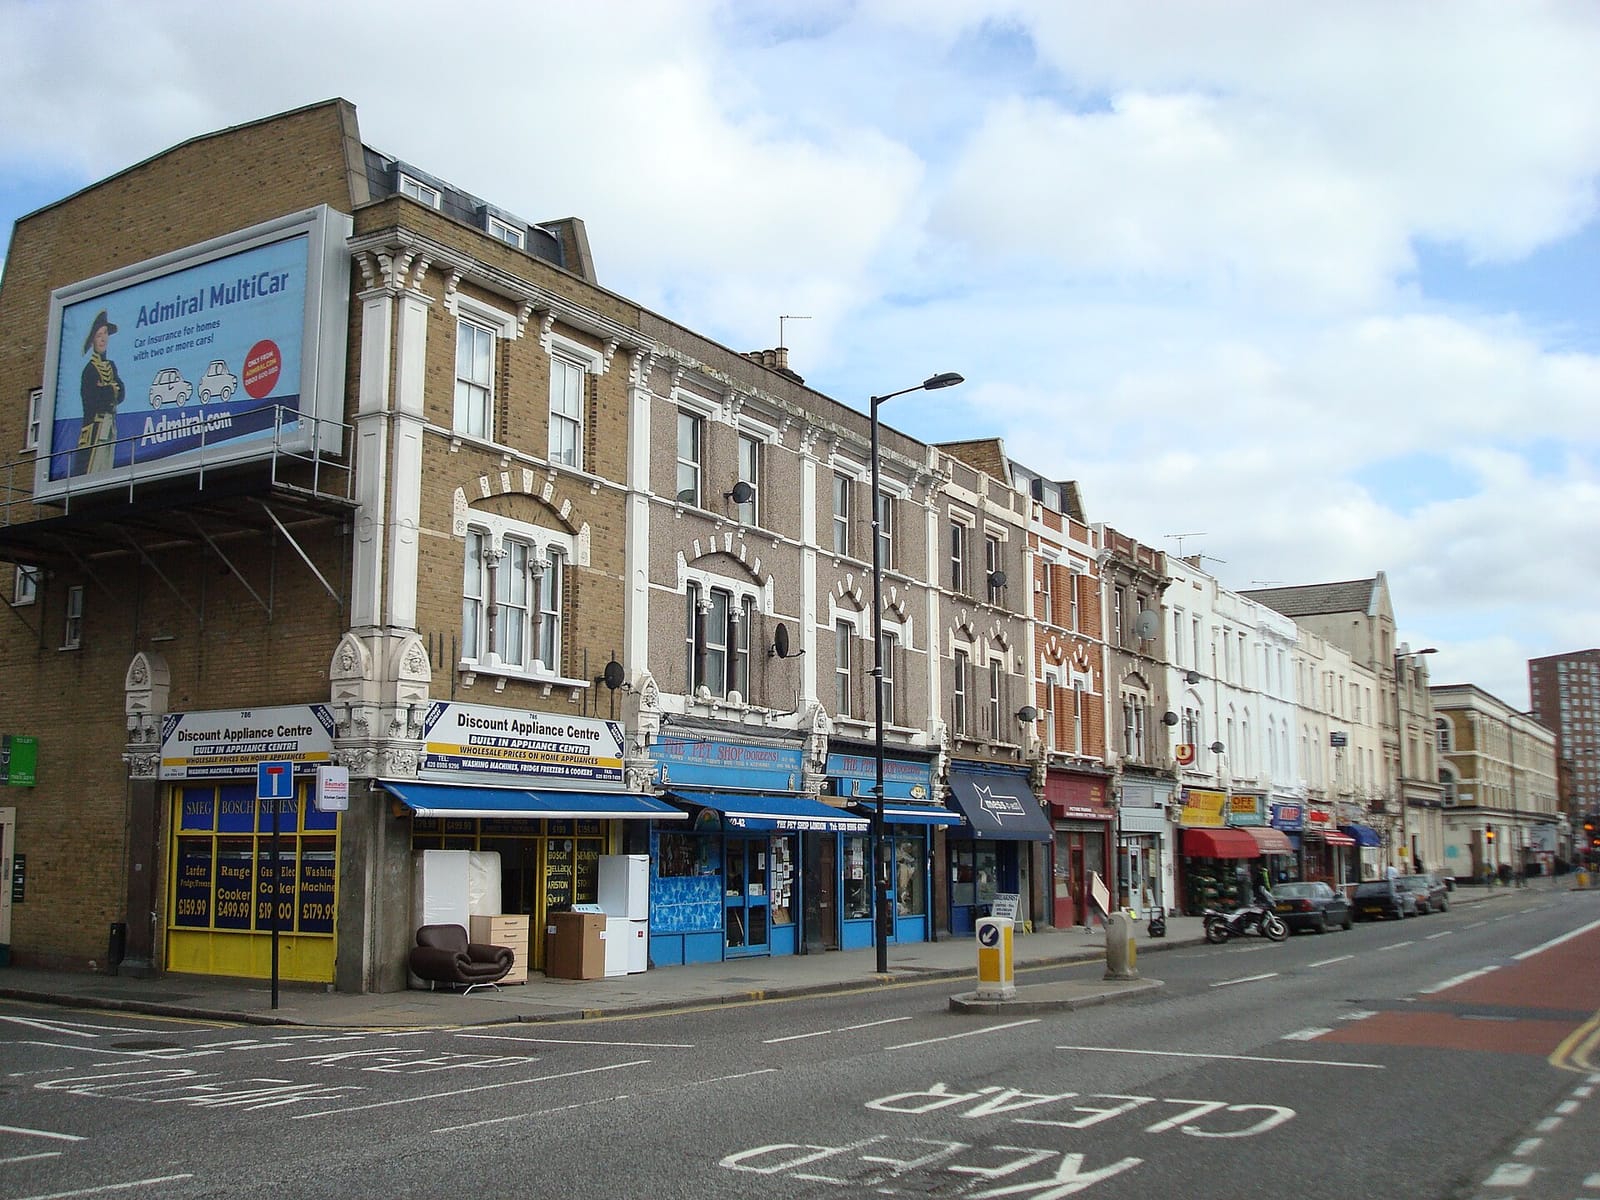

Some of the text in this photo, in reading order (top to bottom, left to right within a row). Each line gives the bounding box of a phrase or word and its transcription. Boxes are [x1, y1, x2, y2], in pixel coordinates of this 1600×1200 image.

[136, 272, 289, 328] Admiral MultiCar
[134, 319, 221, 348] Car insurance for homes
[134, 333, 214, 361] with two or more cars!
[140, 408, 232, 446] Admiral.com
[178, 725, 312, 742] Discount Appliance Centre
[458, 713, 600, 741] Discount Appliance Centre
[194, 742, 298, 754] BUILT IN APPLIANCE CENTRE
[470, 736, 590, 755] BUILT IN APPLIANCE CENTRE
[664, 739, 686, 756] THE
[692, 744, 712, 758] PET
[718, 746, 744, 761] SHOP
[219, 756, 239, 764] PRICES
[251, 754, 268, 762] HOME
[270, 752, 306, 760] APPLIANCES
[460, 746, 598, 765] WHOLESALE PRICES ON HOME APPLIANCES
[462, 760, 489, 769] WASHING
[520, 764, 540, 773] FRIDGE
[541, 766, 565, 775] FREEZERS
[571, 768, 593, 777] COOKERS
[186, 801, 211, 816] SMEG
[222, 800, 254, 814] BOSCH
[1232, 796, 1254, 805] OFF
[786, 820, 796, 829] PET
[548, 851, 567, 860] BOSCH
[186, 865, 206, 876] Larder
[222, 866, 250, 880] Range
[261, 866, 273, 877] Gas
[306, 866, 336, 880] Washing
[218, 888, 250, 900] Cooker
[260, 882, 296, 895] Coker
[178, 899, 206, 916] £159.99
[218, 902, 250, 918] £499.99
[864, 1083, 1297, 1138] CLEAR
